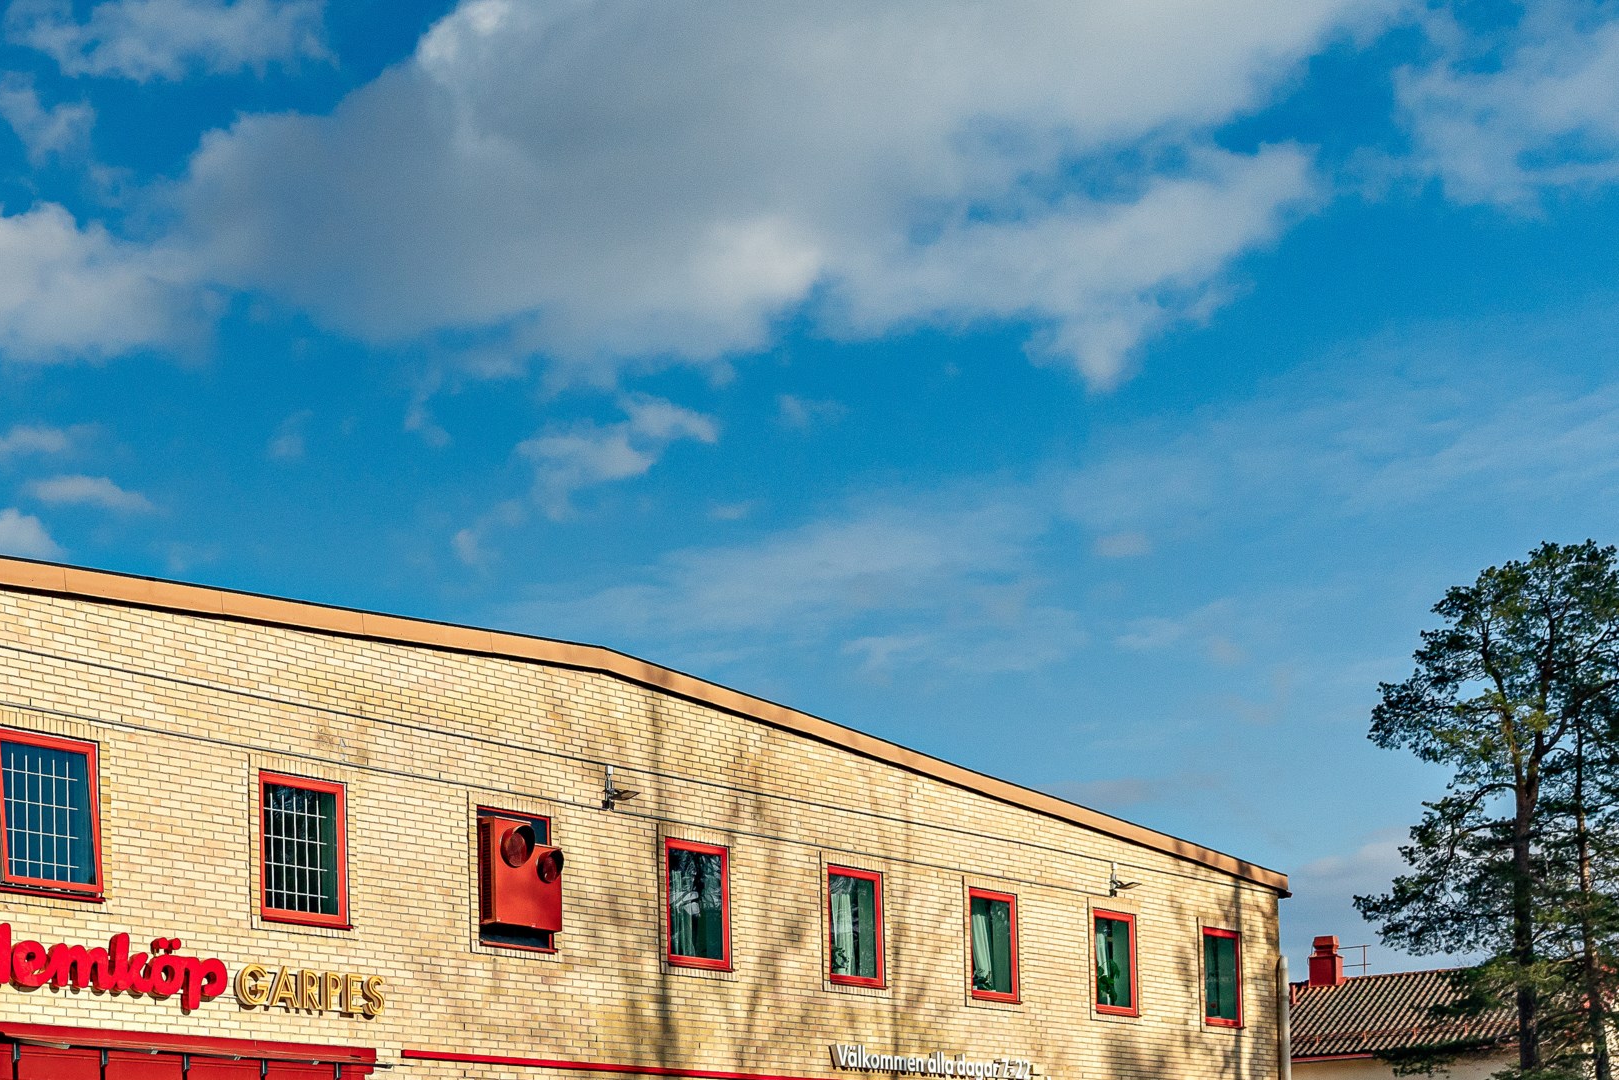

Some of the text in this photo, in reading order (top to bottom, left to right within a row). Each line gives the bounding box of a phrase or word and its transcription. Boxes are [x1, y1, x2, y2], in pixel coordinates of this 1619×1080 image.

[234, 963, 384, 1017] GARPES
[833, 1043, 925, 1073] Välkommen
[927, 1050, 954, 1077] alla
